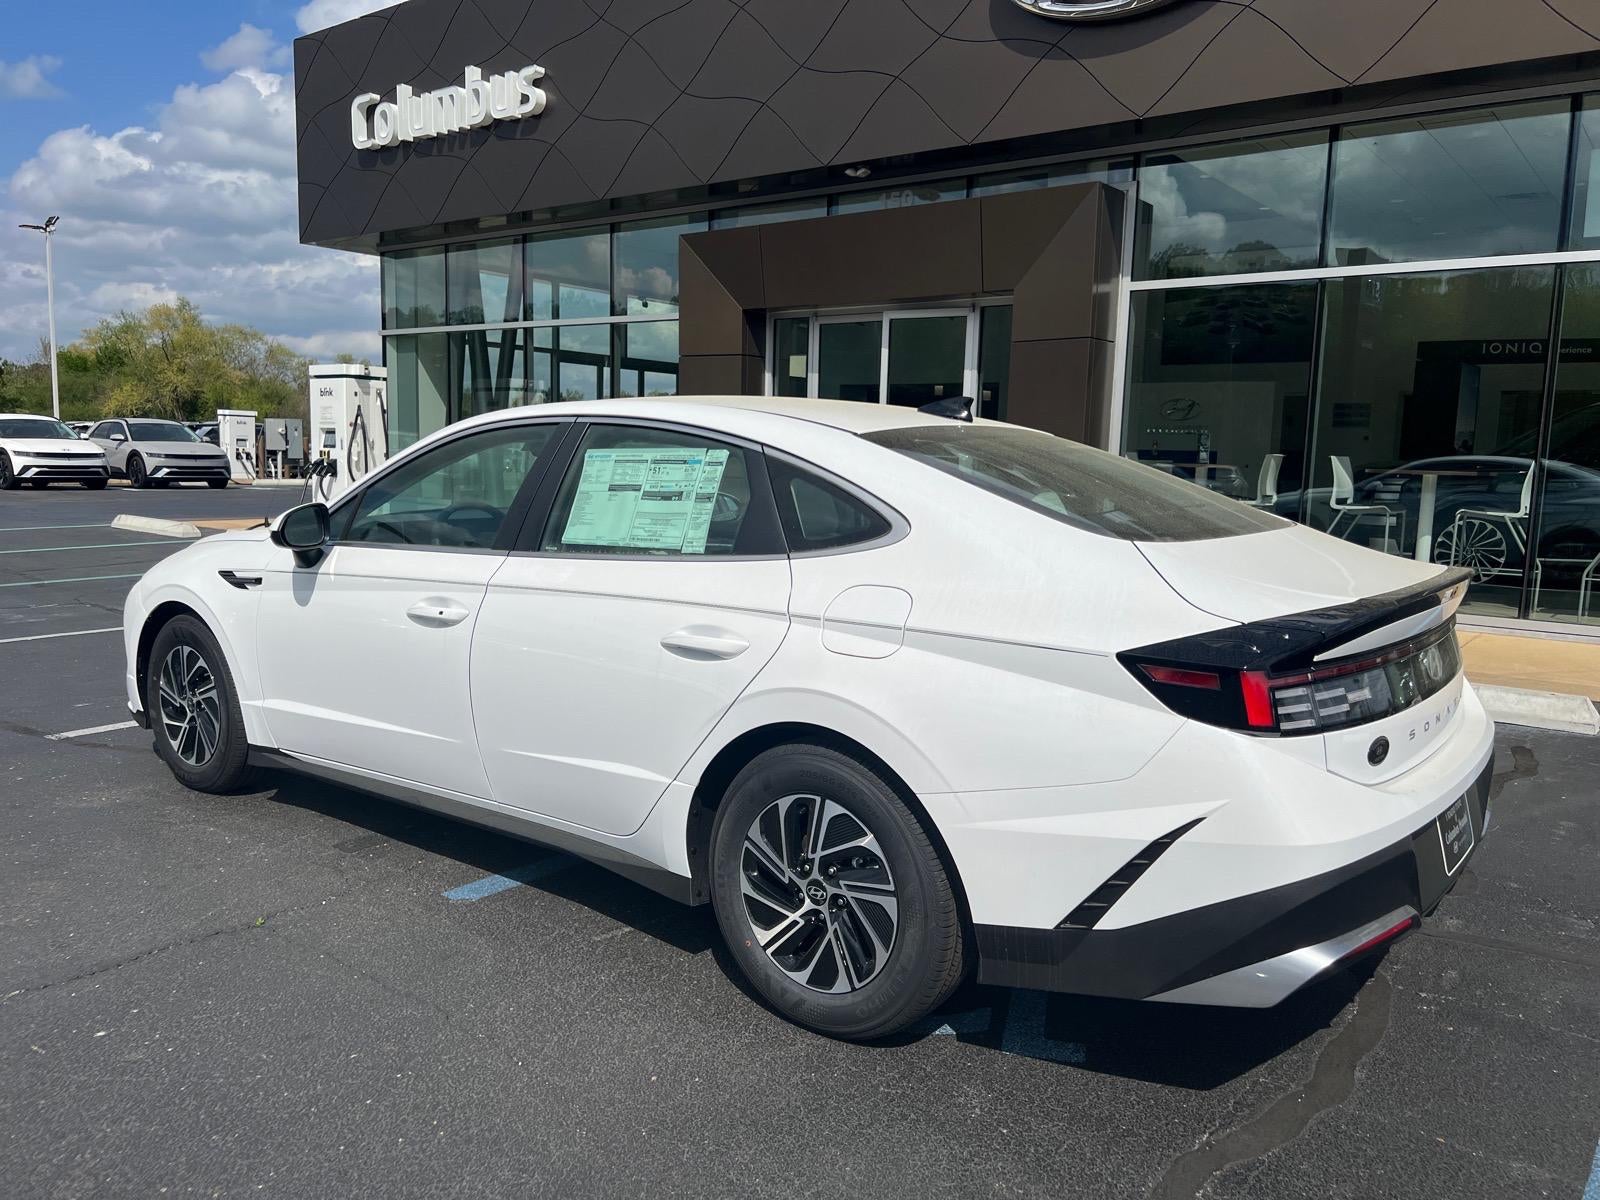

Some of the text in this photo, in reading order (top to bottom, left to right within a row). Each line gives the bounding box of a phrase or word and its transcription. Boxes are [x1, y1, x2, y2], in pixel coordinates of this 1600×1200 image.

[351, 64, 547, 150] Columbus
[1482, 342, 1543, 354] IONIQ
[320, 387, 334, 397] blink
